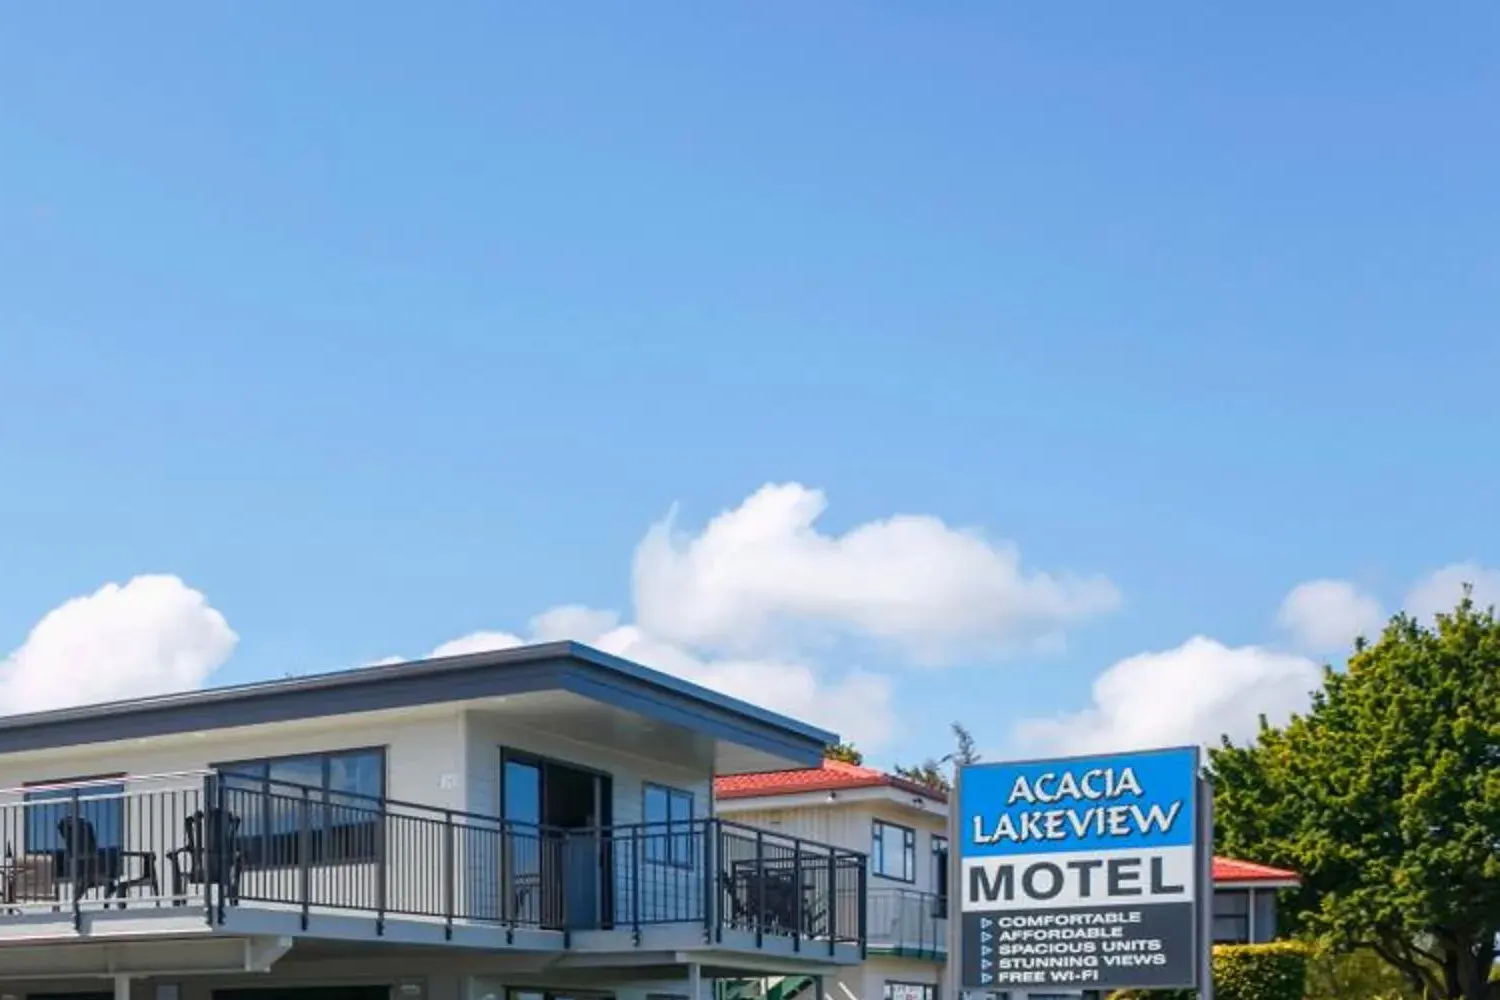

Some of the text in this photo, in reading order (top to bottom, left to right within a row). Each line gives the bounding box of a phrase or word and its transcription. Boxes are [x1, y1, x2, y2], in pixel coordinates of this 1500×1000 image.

[1008, 767, 1142, 803] ACACIA
[973, 801, 1181, 843] LAKEVIEW
[970, 857, 1184, 902] MOTEL
[999, 912, 1141, 928] COMFORTABLE
[999, 927, 1123, 941] AFFORDABLE
[999, 939, 1161, 955] SPACIOUS UNITS
[999, 953, 1166, 970] STUNNING VIEWS
[999, 969, 1098, 983] FREE WI-FI
